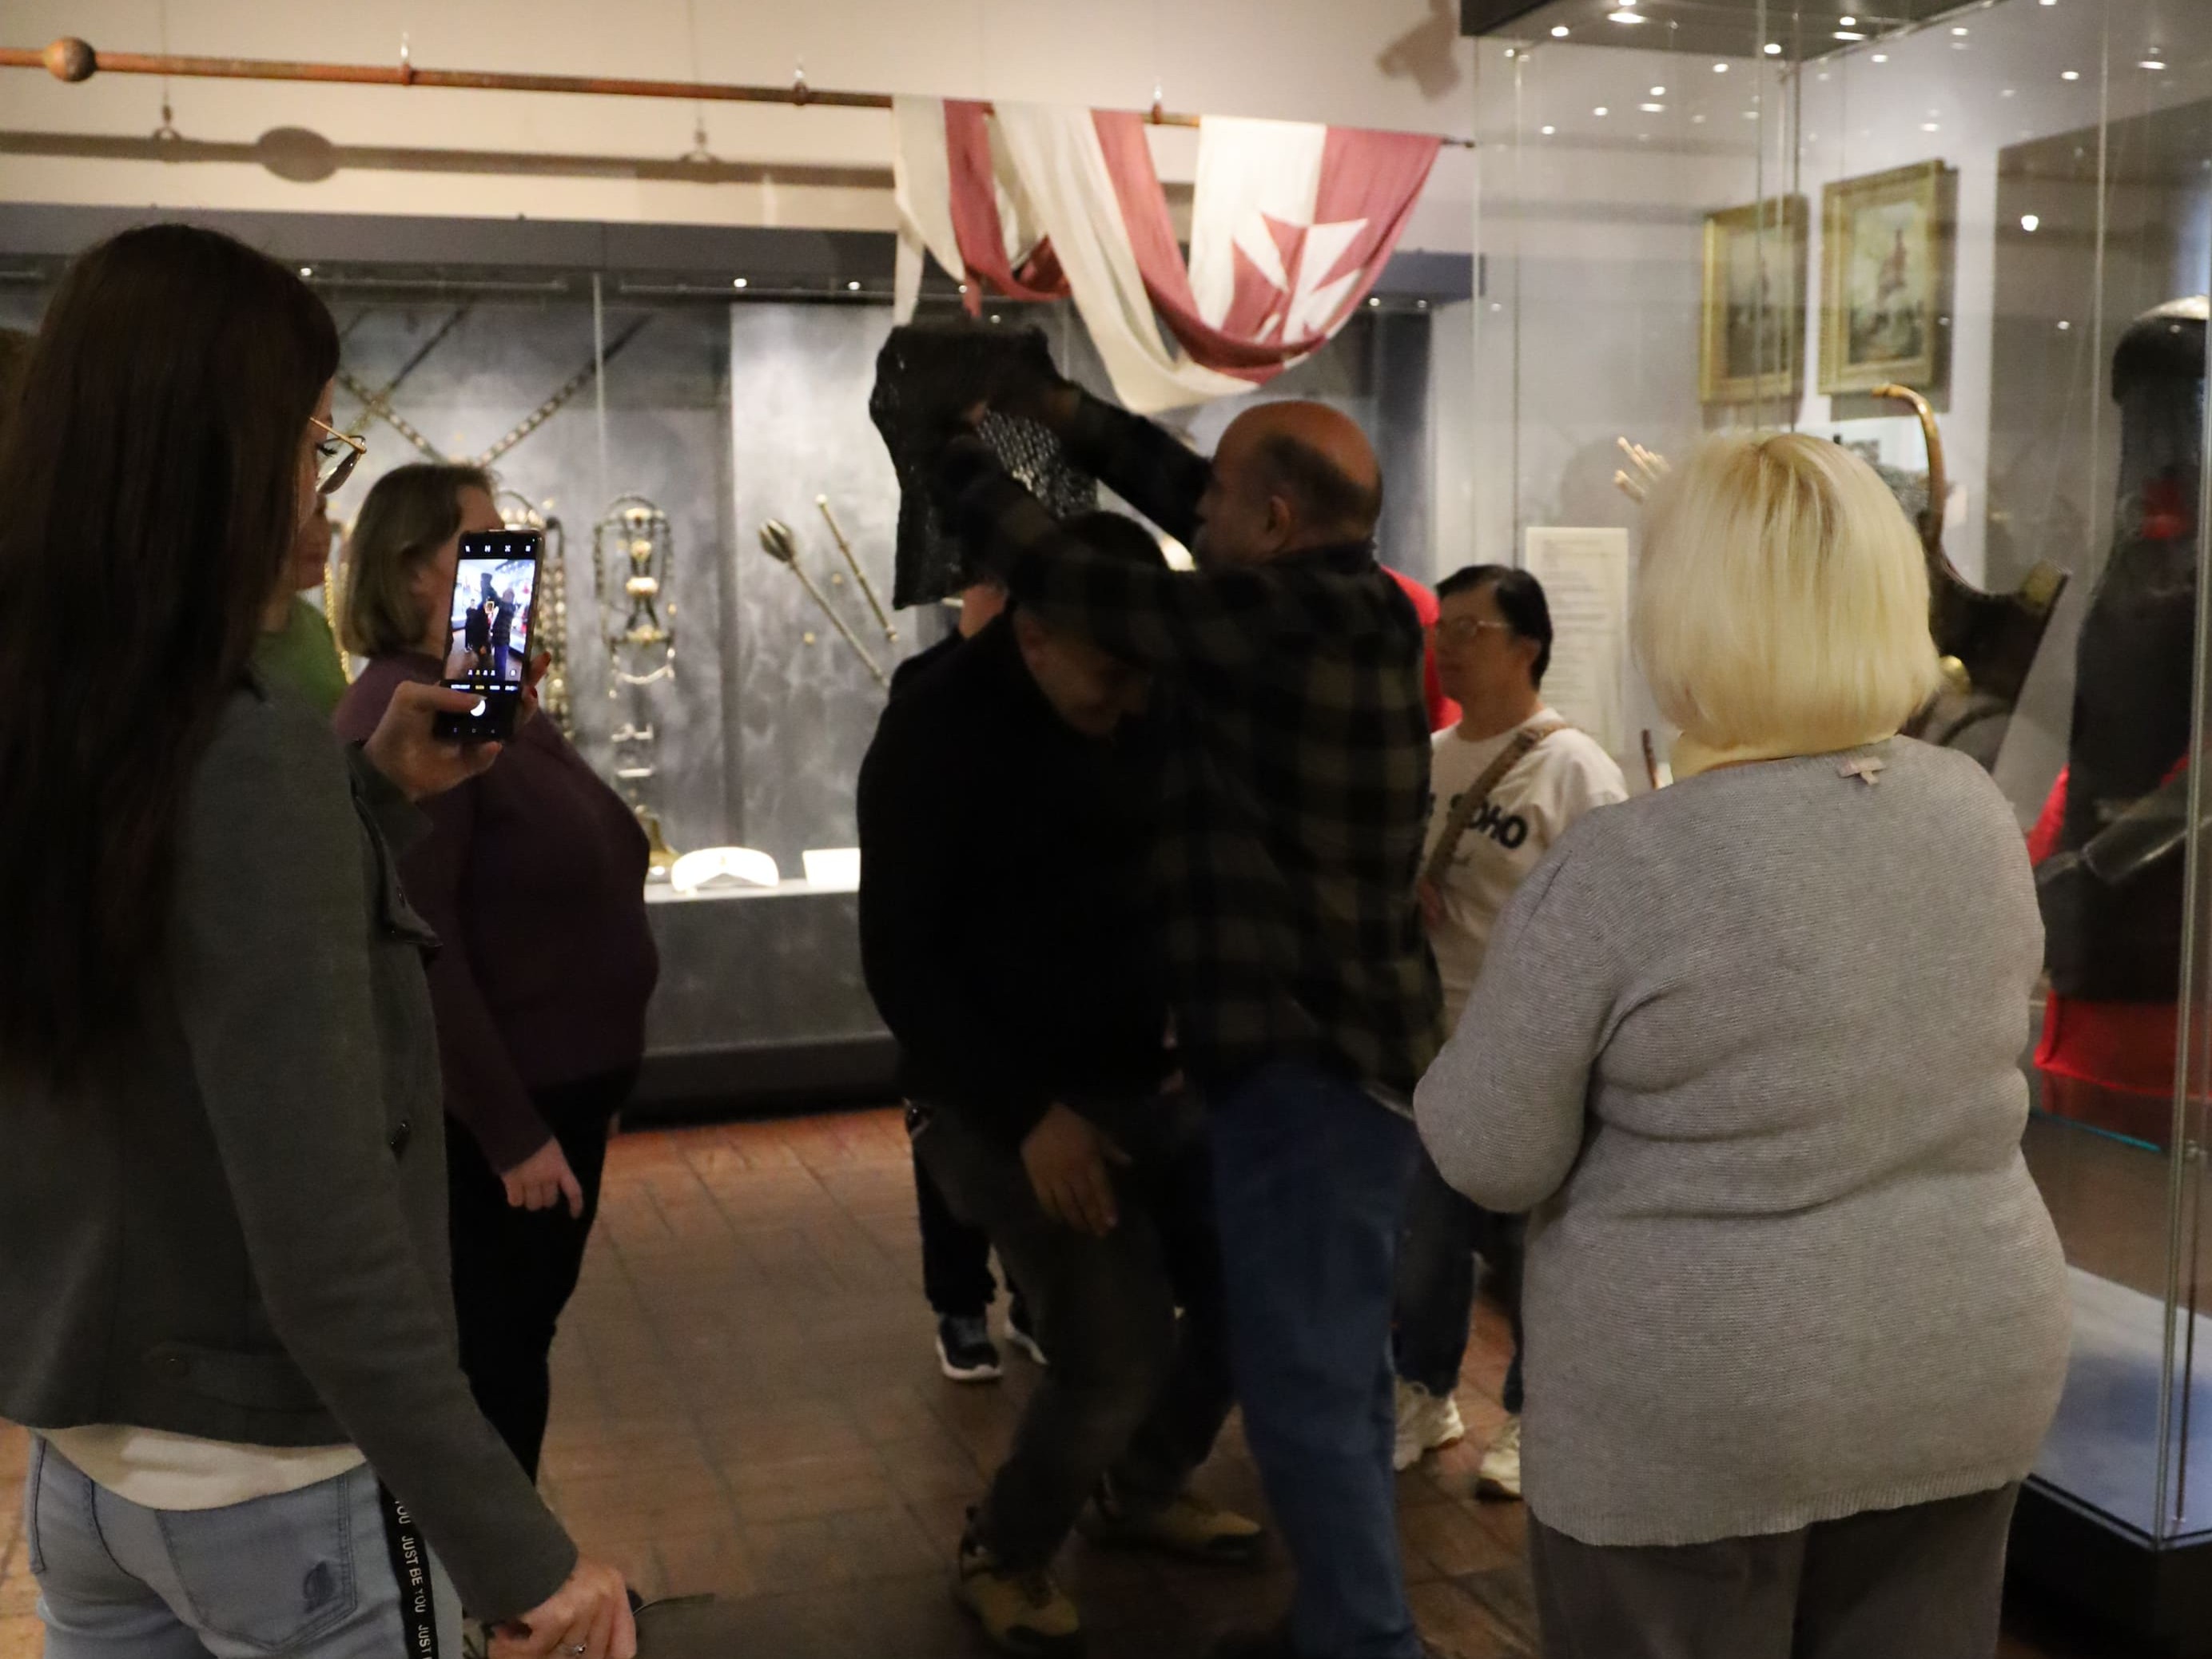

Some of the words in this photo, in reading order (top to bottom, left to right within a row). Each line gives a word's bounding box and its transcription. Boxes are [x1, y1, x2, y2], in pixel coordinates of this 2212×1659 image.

[395, 1501, 411, 1524] OU
[401, 1535, 419, 1565] JUST
[409, 1568, 424, 1585] BE
[414, 1587, 426, 1613] YOU
[418, 1624, 432, 1653] JUST
